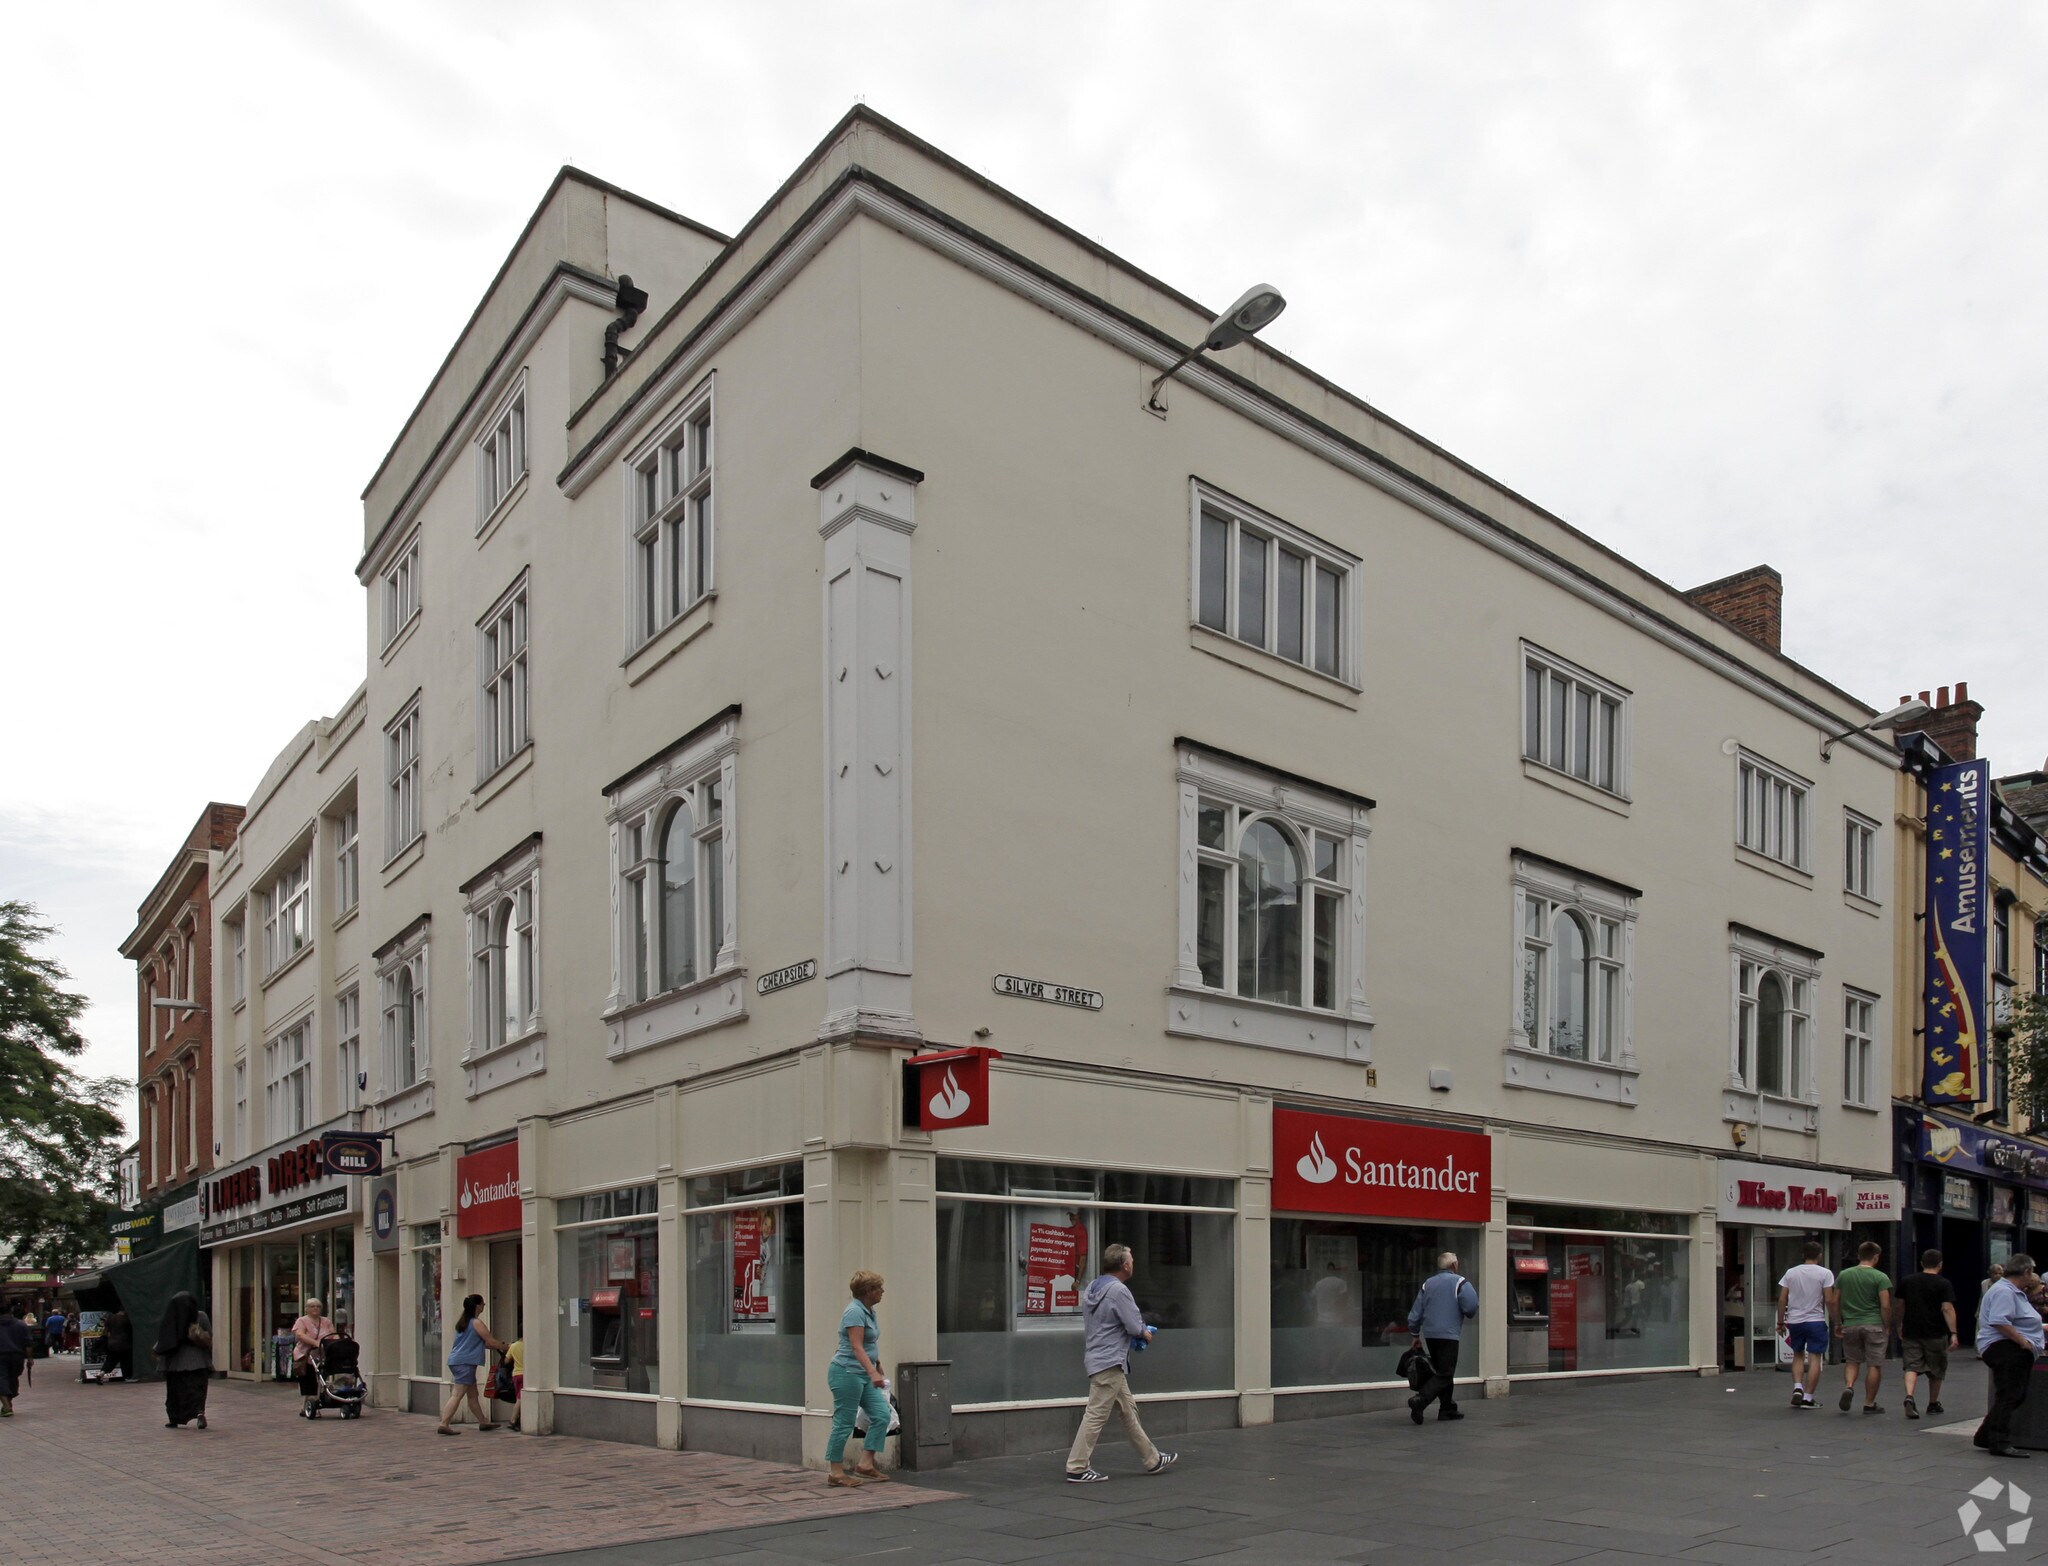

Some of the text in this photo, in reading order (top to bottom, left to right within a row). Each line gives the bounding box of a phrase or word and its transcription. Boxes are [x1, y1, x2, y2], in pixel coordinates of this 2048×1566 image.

[1951, 769, 1977, 934] Amusements
[762, 963, 809, 990] CHEAPSIDE
[1005, 978, 1095, 1006] SILVER STREET
[267, 1139, 325, 1195] DIREC
[340, 1156, 368, 1168] HILL
[1345, 1146, 1480, 1194] Santander
[286, 1205, 301, 1219] Towels
[316, 1192, 345, 1210] Furnishings
[1737, 1180, 1838, 1214] Miss Nails
[1855, 1201, 1891, 1210] Nails
[1857, 1192, 1890, 1201] Miss
[110, 1215, 155, 1234] SUBWAY
[378, 1211, 390, 1231] HILL
[1031, 1236, 1075, 1248] Santander mortgage
[1030, 1255, 1048, 1263] Current
